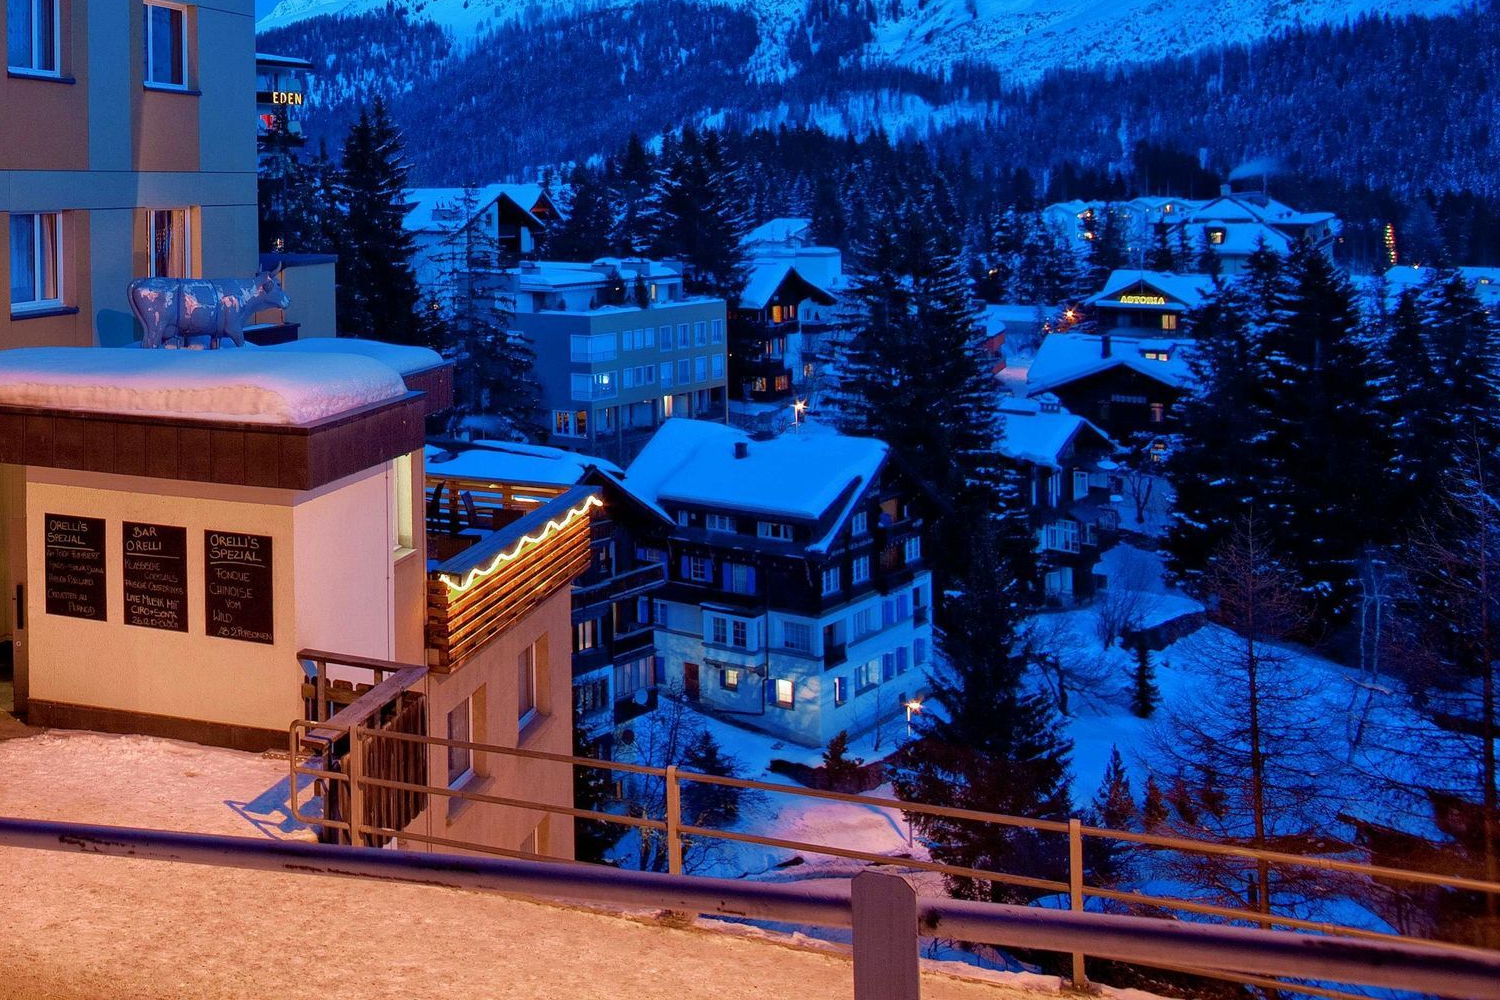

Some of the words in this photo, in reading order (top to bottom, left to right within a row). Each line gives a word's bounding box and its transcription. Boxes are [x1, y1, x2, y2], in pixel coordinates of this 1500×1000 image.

[272, 91, 302, 105] EDEN
[1119, 294, 1166, 305] ASTORIA
[47, 532, 86, 545] SPEZIAL
[132, 526, 158, 538] BAR
[126, 540, 162, 551] ORELLI
[210, 534, 260, 549] ORELLI'S
[209, 547, 262, 562] SPEZIAL
[214, 568, 251, 582] FONDUE
[209, 582, 253, 599] CHINOISE
[212, 609, 233, 624] WILD
